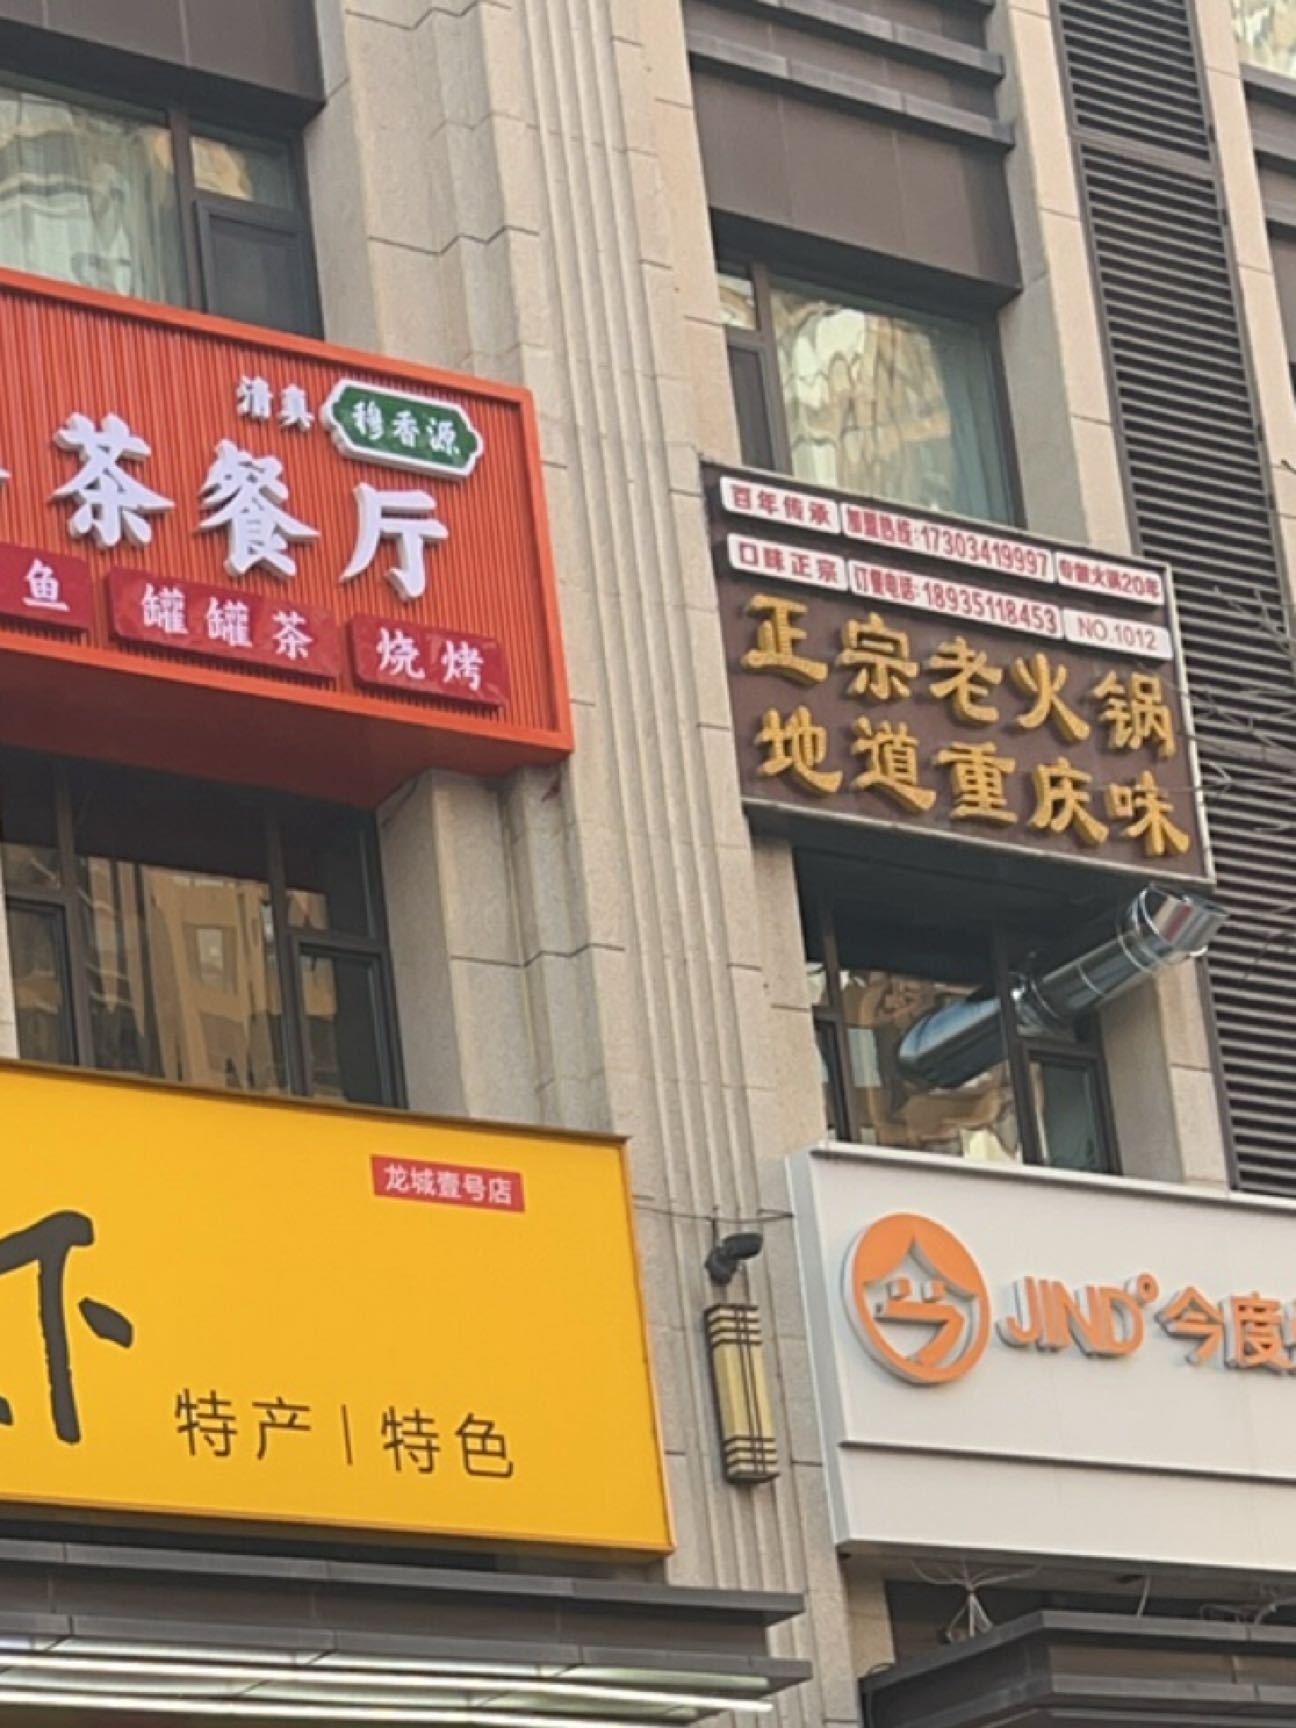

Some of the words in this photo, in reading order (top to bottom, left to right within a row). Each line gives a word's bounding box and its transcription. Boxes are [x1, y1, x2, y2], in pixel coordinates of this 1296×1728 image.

[236, 376, 314, 431] 清真
[353, 400, 459, 455] 穆香源
[49, 411, 449, 600] 茶餐厅
[739, 542, 838, 584] 口味正宗
[141, 584, 313, 660] 罐罐茶
[377, 628, 484, 692] 烧烤
[741, 593, 1177, 759] 正宗老火锅
[753, 706, 1190, 857] 地道重庆味
[383, 1163, 513, 1205] 龙城壹号店
[1160, 1286, 1296, 1374] 今度
